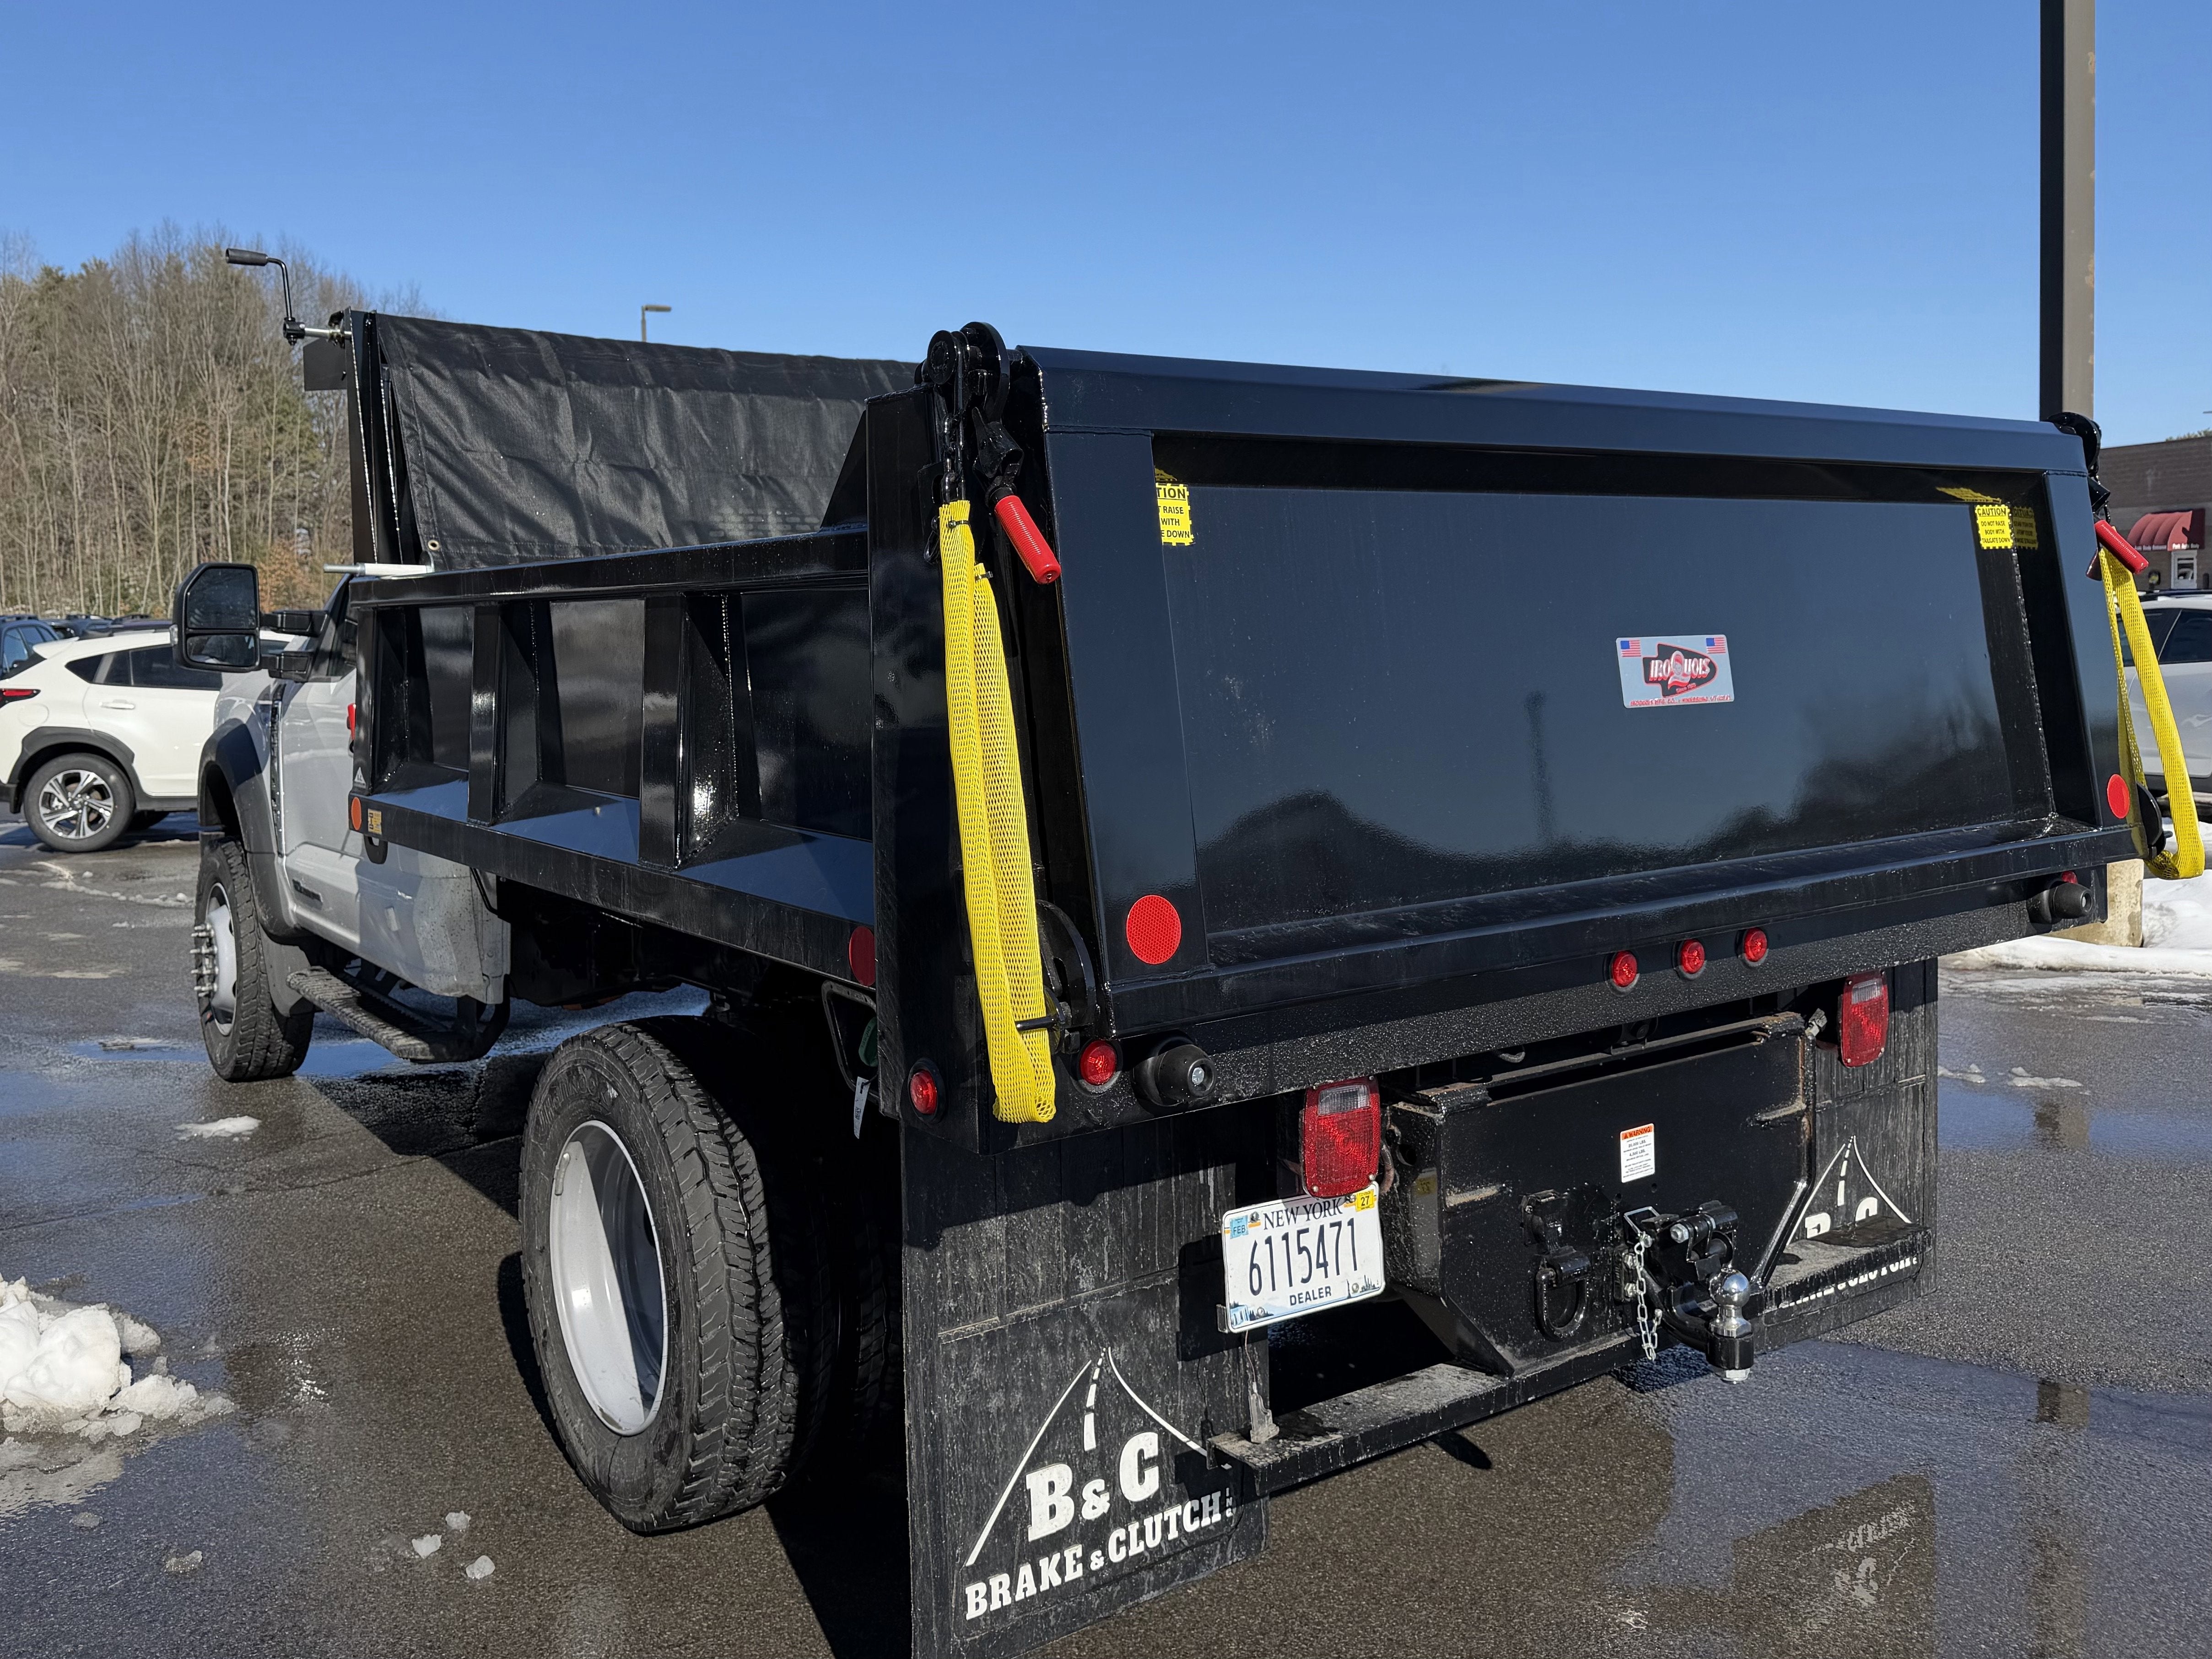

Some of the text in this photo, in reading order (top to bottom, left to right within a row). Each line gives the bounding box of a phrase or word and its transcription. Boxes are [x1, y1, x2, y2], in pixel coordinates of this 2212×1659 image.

[1157, 487, 1186, 499] TION
[1163, 506, 1184, 514] RAISE
[1977, 508, 2007, 516] CAUTION
[1161, 517, 1180, 526] WITH
[1649, 651, 1710, 689] IROQUOIS
[1361, 1195, 1370, 1207] 27
[1263, 1197, 1343, 1230] NEW YORK
[1233, 1225, 1246, 1235] FEB
[1249, 1217, 1358, 1296] 6115471
[1289, 1286, 1332, 1306] DEALER
[1026, 1432, 1159, 1542] B & C
[966, 1544, 1084, 1620] BRAKE
[1090, 1550, 1105, 1571] &
[1108, 1491, 1221, 1564] CLUTCH
